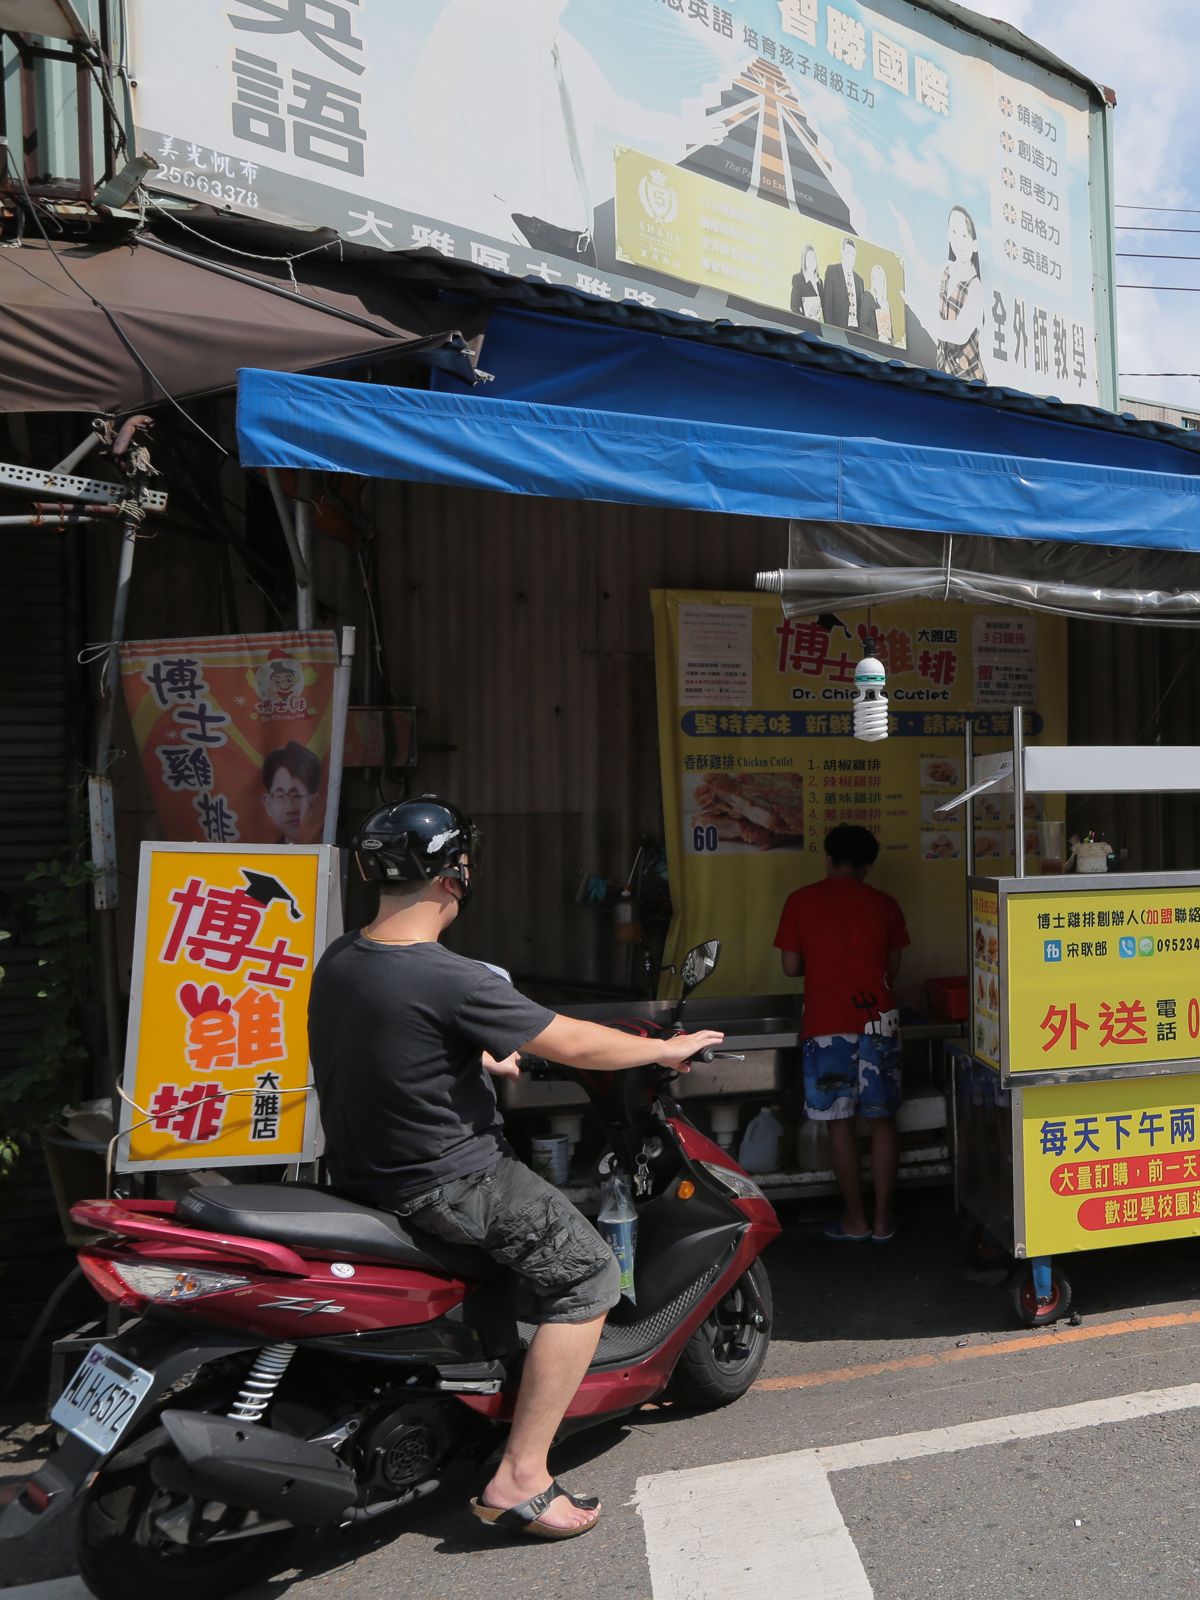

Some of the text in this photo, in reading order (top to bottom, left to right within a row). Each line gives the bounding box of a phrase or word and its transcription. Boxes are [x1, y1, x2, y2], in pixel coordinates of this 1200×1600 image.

[743, 25, 876, 109] 培育孩子超級五力
[1017, 104, 1057, 143] 領導力
[1018, 140, 1058, 177] 創造力
[155, 163, 259, 208] 25663378
[762, 176, 772, 186] to
[1019, 174, 1059, 212] 思考力
[1021, 210, 1061, 246] 品格力
[1022, 247, 1062, 280] 英語力
[992, 290, 1086, 388] 全外師教學
[918, 629, 957, 644] 大雅店
[793, 688, 815, 700] Dr.
[894, 688, 949, 700] Cutlet
[147, 658, 235, 843] 博士雞排
[684, 754, 794, 770] 香酥雞排 Chicken Cutlet
[823, 759, 881, 771] 胡椒雞排
[693, 825, 718, 852] 60
[1066, 941, 1107, 958] 宋耿郎
[1039, 1000, 1149, 1052] 外送
[1156, 999, 1178, 1042] 電話
[252, 1072, 280, 1140] 大雅店
[64, 1363, 138, 1433] MLH-6572
